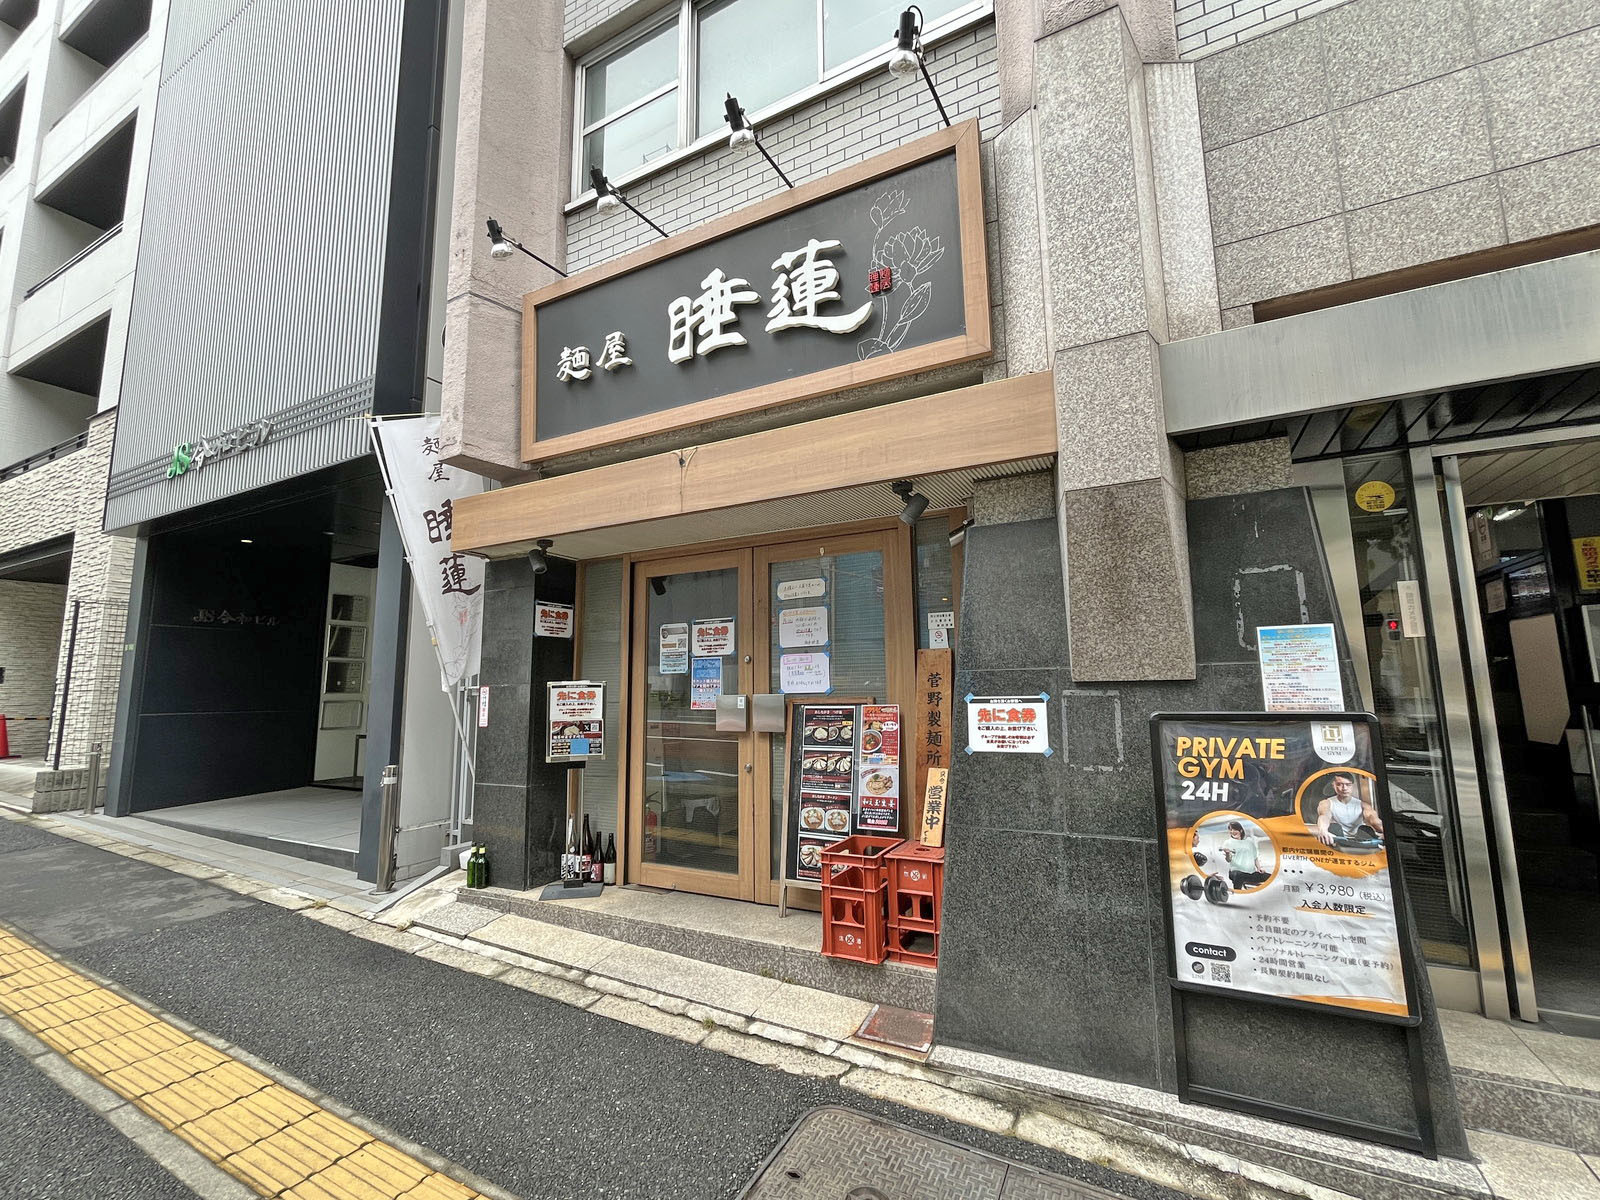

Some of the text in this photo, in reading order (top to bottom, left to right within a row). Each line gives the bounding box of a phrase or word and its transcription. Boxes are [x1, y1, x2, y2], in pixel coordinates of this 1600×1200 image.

[556, 238, 875, 382] 麺屋 睡蓮
[556, 690, 597, 701] 先に食券
[926, 671, 945, 767] 菅野製麺所
[977, 707, 1037, 723] 先に食券
[1176, 736, 1286, 760] PRIVATE
[1177, 757, 1245, 780] GYM
[1181, 780, 1229, 802] 24H
[925, 785, 944, 831] 営業中
[1282, 854, 1376, 868] LIVERTH ONEが運営するジム
[1282, 884, 1300, 893] 月額
[1301, 899, 1367, 915] 入会人数限定
[1256, 914, 1290, 925] 予約不要
[1256, 924, 1367, 945] 会員限定のプライベート空間
[1192, 946, 1227, 957] contact
[1259, 956, 1306, 970] 24時間営業
[1260, 966, 1330, 984] 長期契約制限なし
